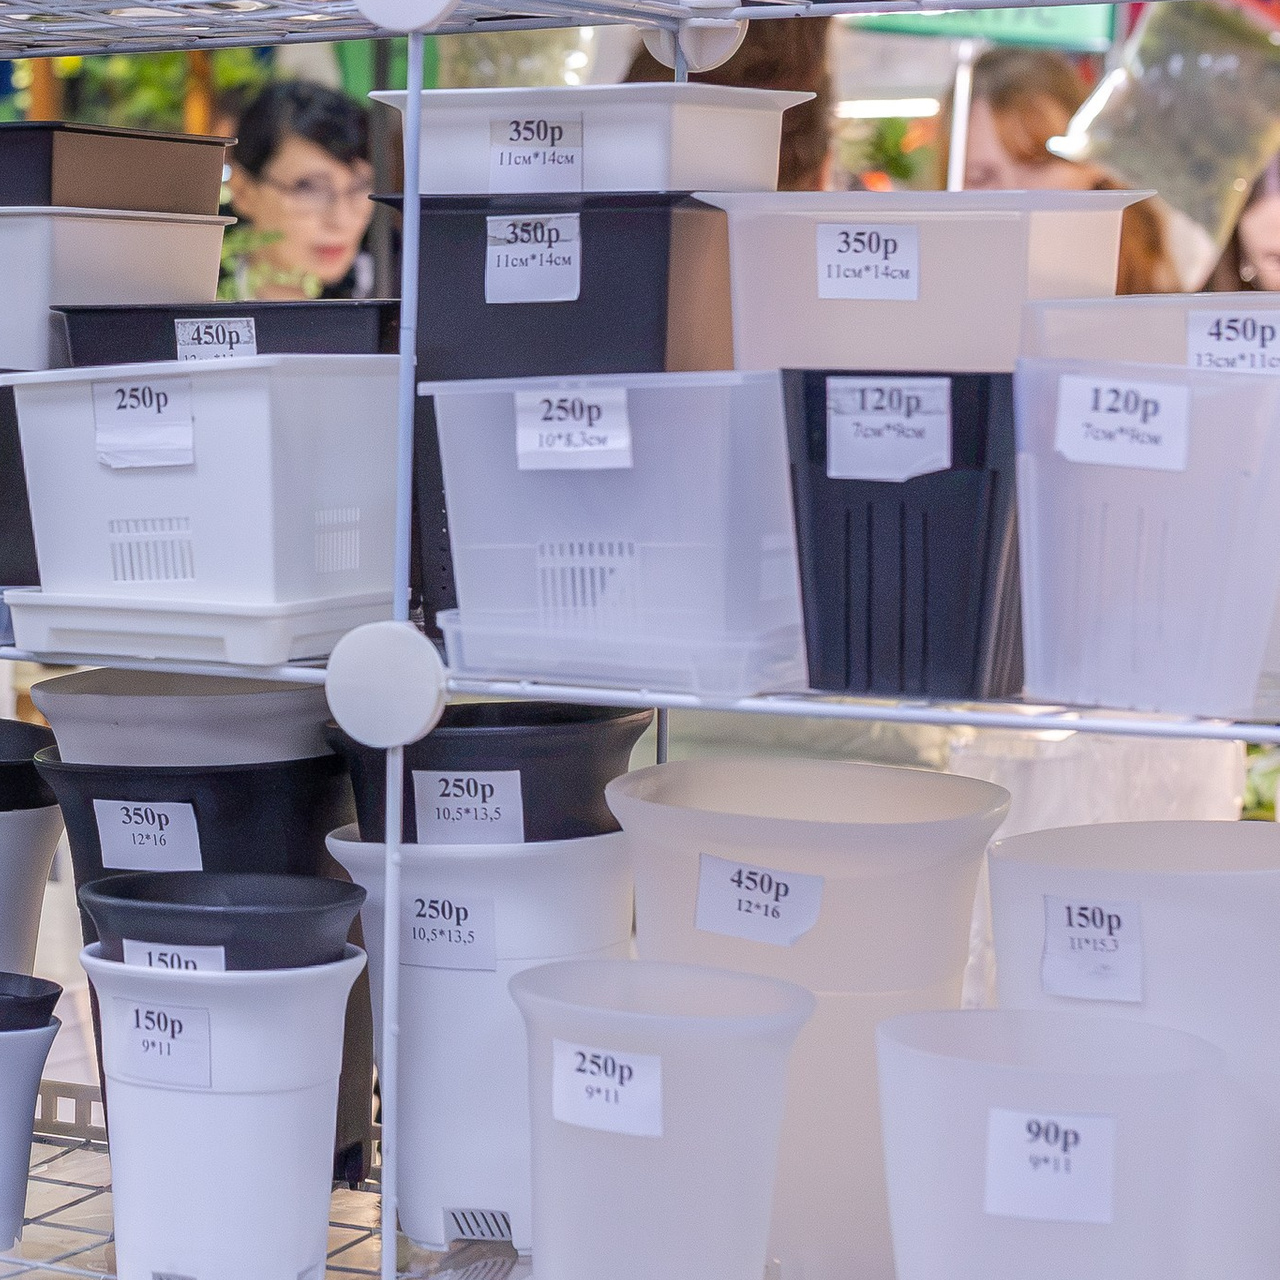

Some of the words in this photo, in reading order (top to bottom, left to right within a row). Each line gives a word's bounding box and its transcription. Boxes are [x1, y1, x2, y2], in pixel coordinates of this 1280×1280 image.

[508, 120, 562, 147] 350р
[506, 221, 561, 249] 350р
[836, 231, 898, 260] 350р
[190, 324, 241, 350] 450р
[1206, 317, 1276, 350] 450р
[114, 385, 168, 414] 250р
[539, 398, 602, 427] 250р
[858, 387, 921, 418] 120р
[1090, 387, 1159, 424] 120р
[437, 777, 494, 804] 250р
[120, 805, 170, 831] 350р
[729, 868, 790, 902] 450р
[414, 898, 469, 926] 250р
[1064, 905, 1121, 936] 150р
[132, 1008, 183, 1039] 150р
[574, 1051, 633, 1087] 250р
[1025, 1120, 1080, 1154] 90р
